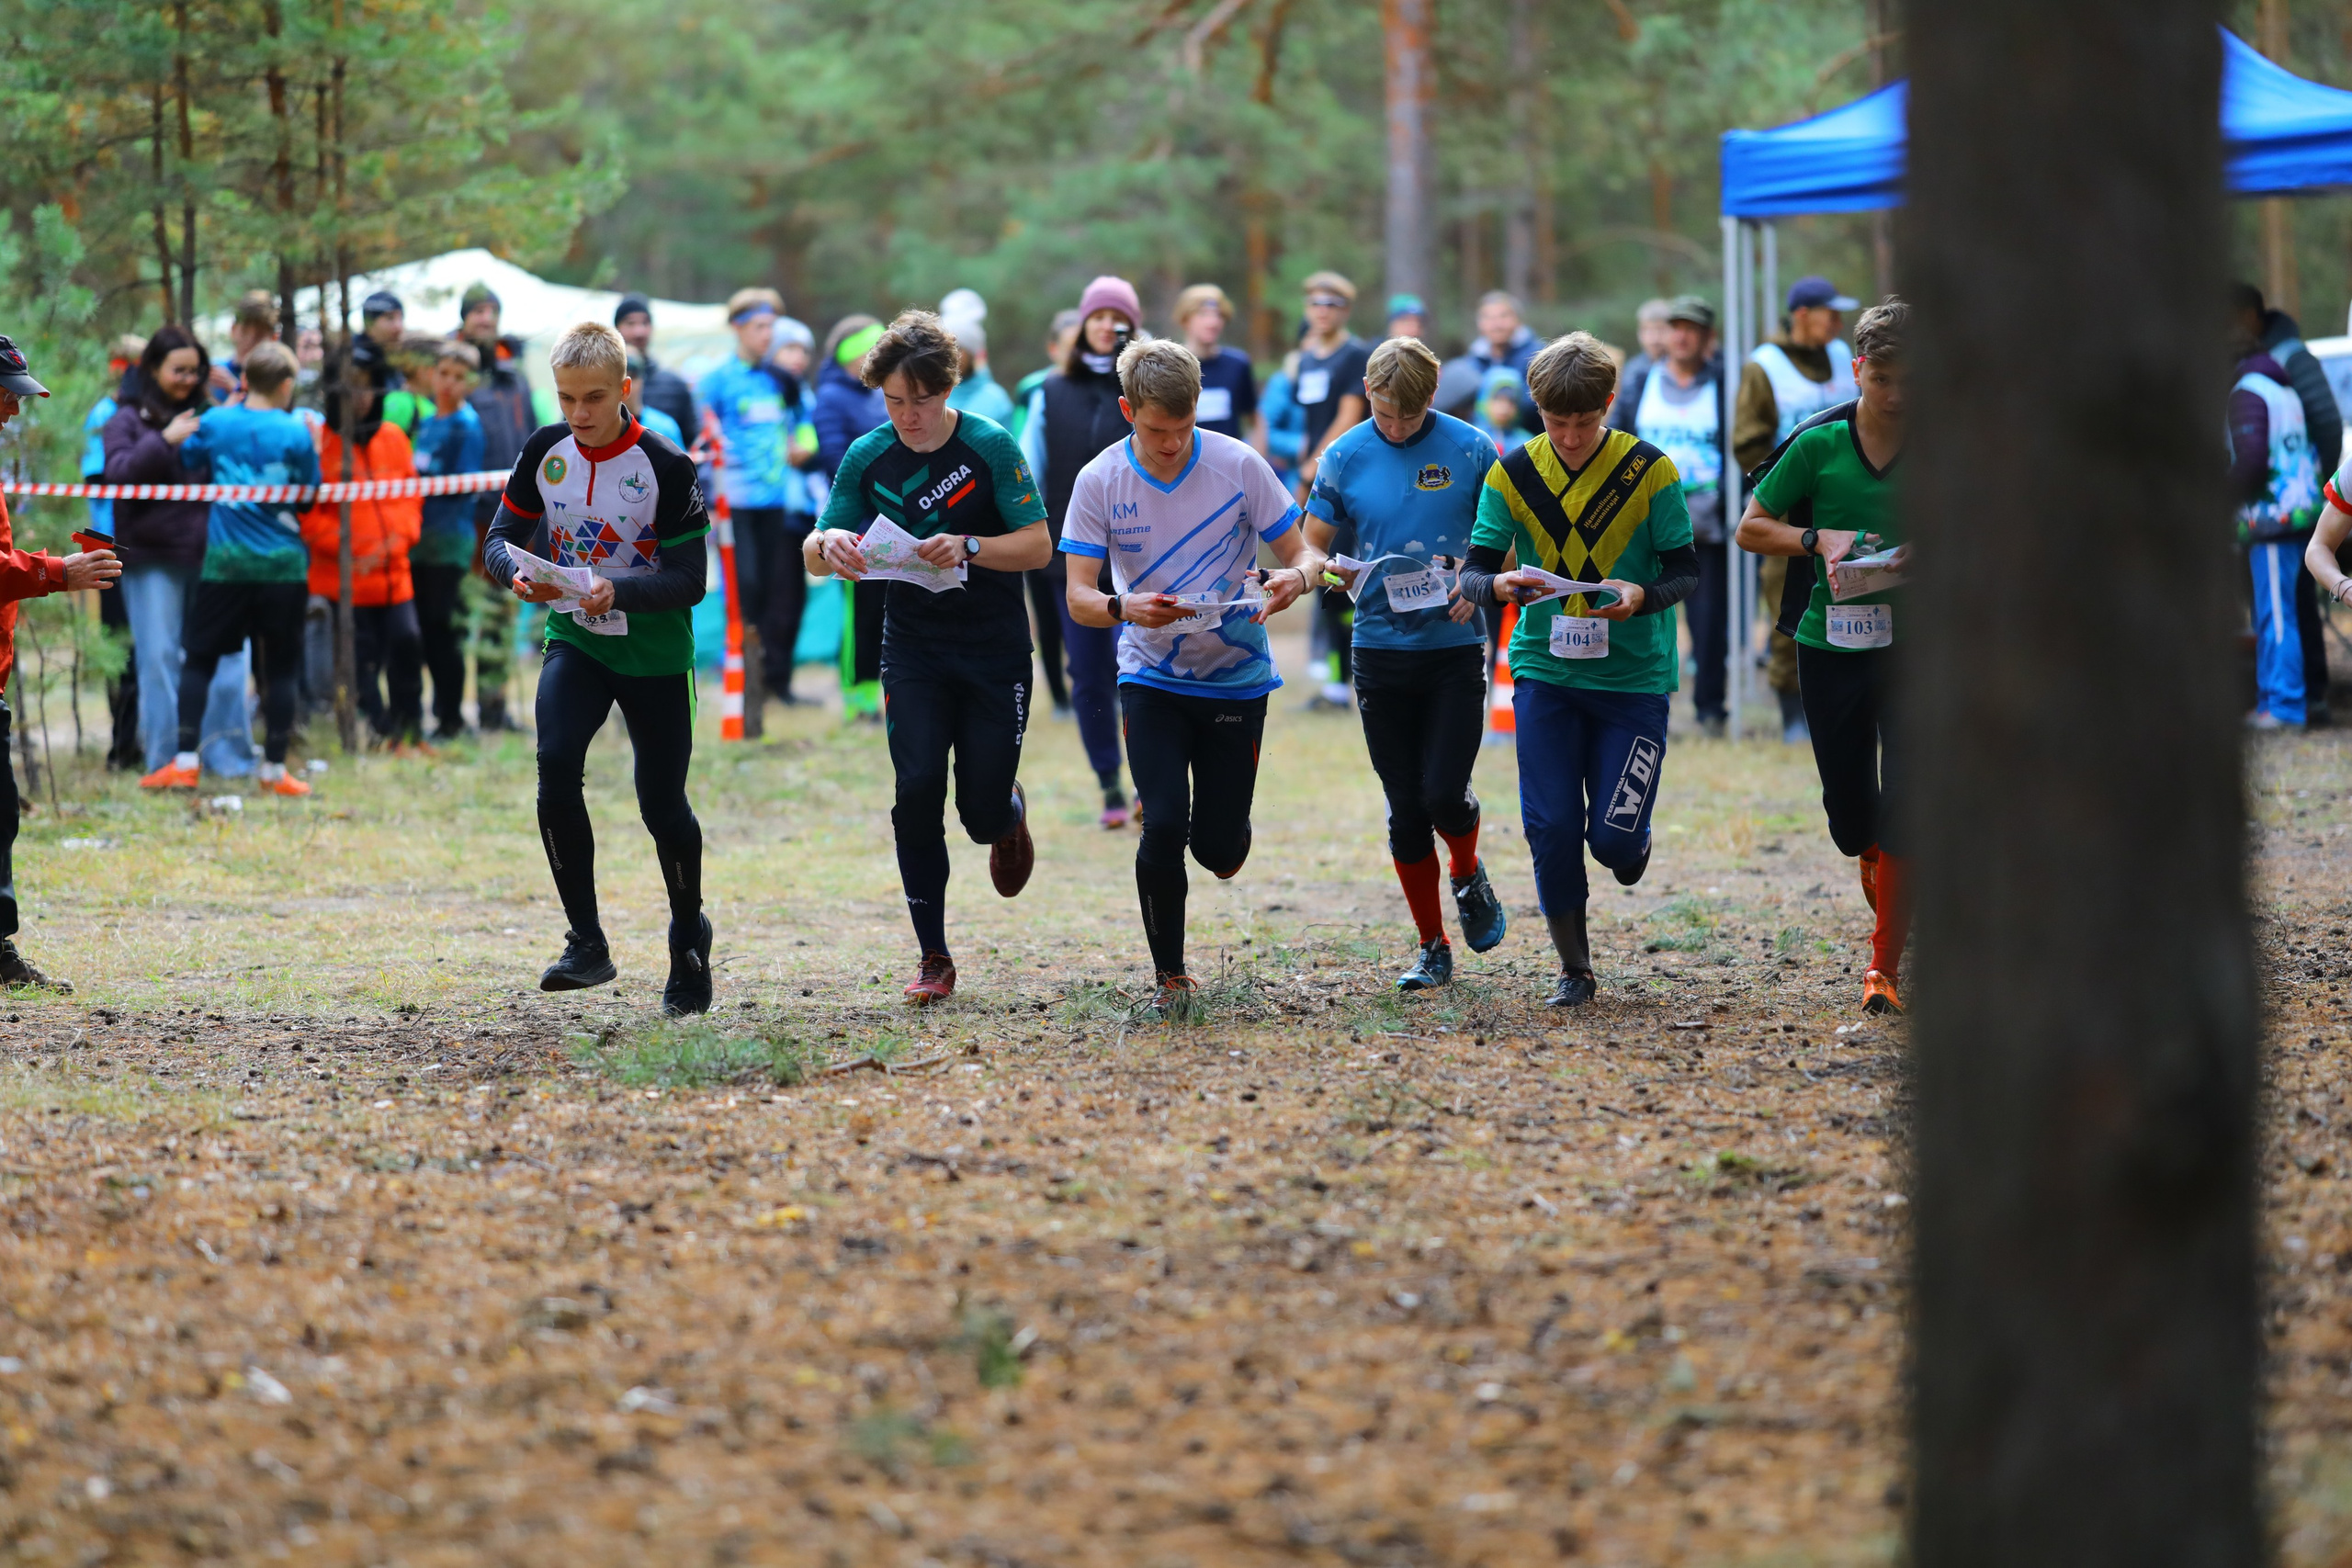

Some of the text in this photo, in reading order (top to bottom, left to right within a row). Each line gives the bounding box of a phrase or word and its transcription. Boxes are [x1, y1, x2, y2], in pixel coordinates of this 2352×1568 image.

[919, 464, 972, 510] O-UGRA
[1113, 502, 1138, 520] KM
[1583, 489, 1617, 528] Hämeenlinnan
[1590, 495, 1620, 530] Suunnistajat
[1405, 582, 1430, 598] 105
[1565, 632, 1590, 647] 104
[1846, 620, 1873, 635] 103
[1605, 777, 1626, 818] WESTERVESA
